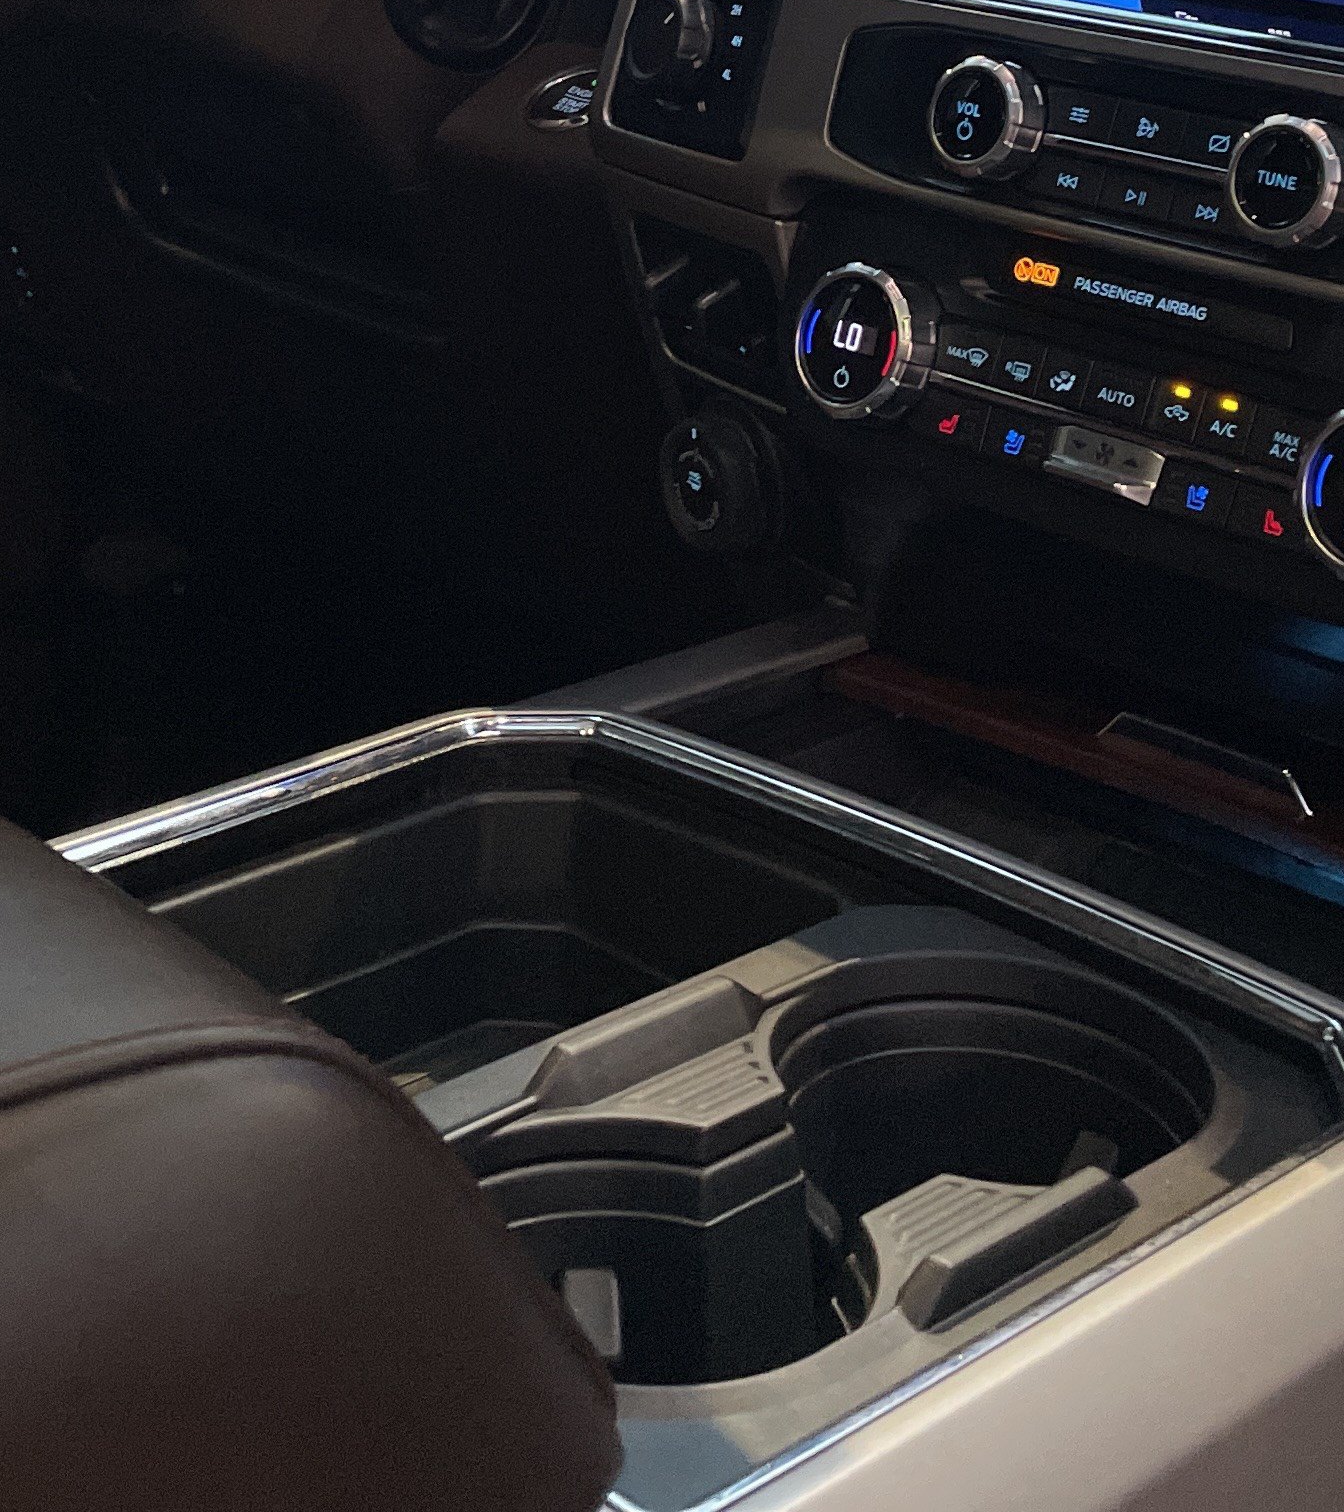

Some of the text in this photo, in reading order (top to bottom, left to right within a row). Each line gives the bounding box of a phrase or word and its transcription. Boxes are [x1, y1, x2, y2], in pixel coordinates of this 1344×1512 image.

[956, 101, 981, 119] VOL
[1257, 169, 1298, 192] TUNE
[1036, 266, 1056, 284] ON
[1073, 276, 1208, 321] PASSENGER AIRBAG
[833, 320, 863, 352] LO
[946, 345, 968, 360] MAX
[1097, 387, 1136, 408] AUTO
[1209, 420, 1238, 438] A/C
[1272, 431, 1301, 448] MAX
[1269, 444, 1298, 462] A/C
